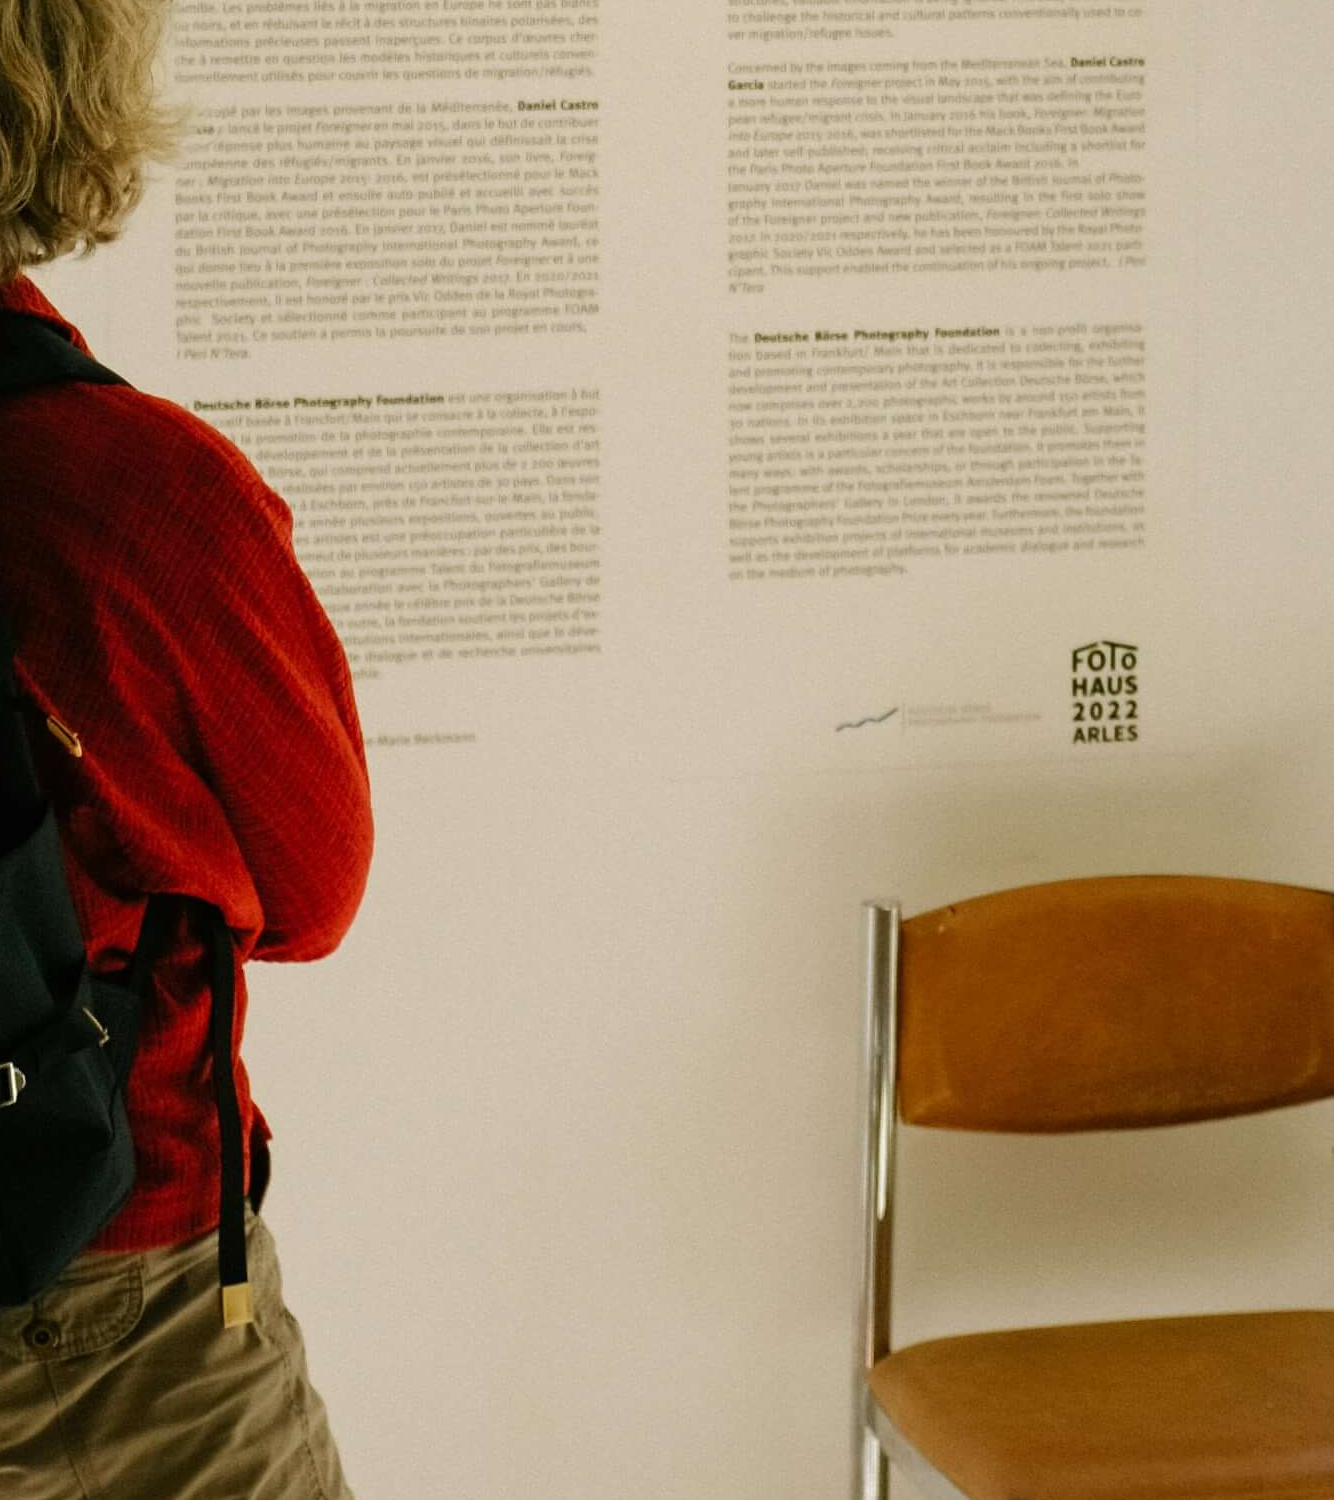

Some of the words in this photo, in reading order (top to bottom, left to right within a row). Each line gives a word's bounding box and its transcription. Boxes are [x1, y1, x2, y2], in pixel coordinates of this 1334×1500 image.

[1069, 57, 1107, 69] Daniel
[1108, 56, 1144, 68] Castro
[728, 79, 764, 91] Garcia
[515, 100, 557, 112] Daniel
[559, 100, 599, 112] Castro
[753, 330, 809, 343] Deutsche
[813, 329, 848, 342] Börse
[853, 327, 929, 344] Photography
[933, 326, 1001, 339] Foundation
[195, 398, 251, 410] Deutsche
[253, 397, 290, 409] Börse
[292, 395, 372, 411] Photography
[375, 393, 446, 406] Foundation
[1071, 674, 1139, 698] HAUS
[1072, 699, 1139, 722] 2022
[1072, 723, 1139, 745] ARLES
